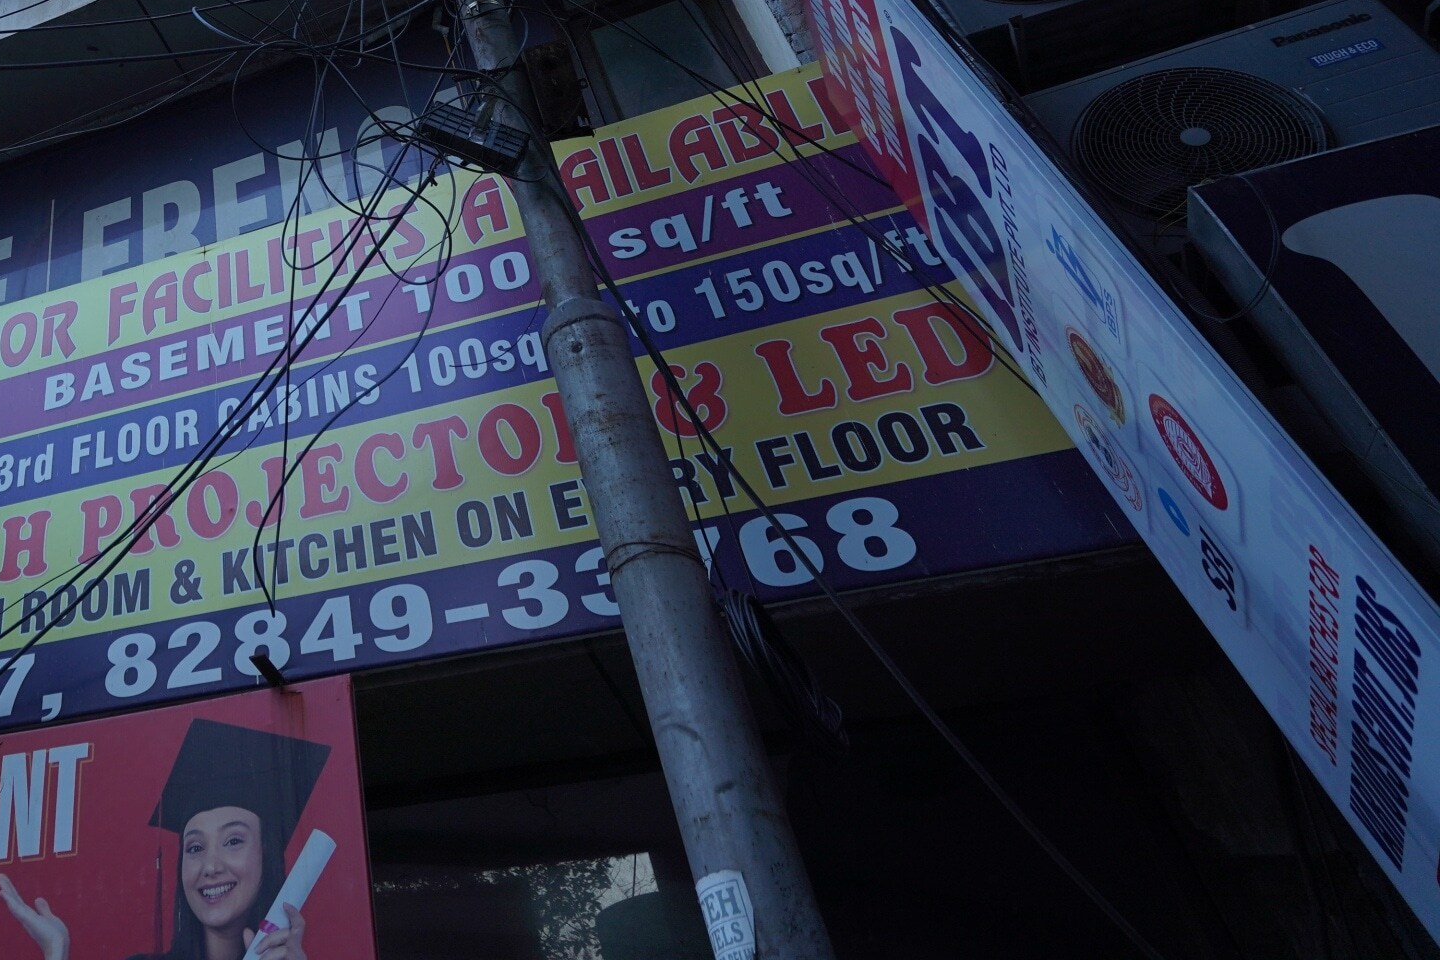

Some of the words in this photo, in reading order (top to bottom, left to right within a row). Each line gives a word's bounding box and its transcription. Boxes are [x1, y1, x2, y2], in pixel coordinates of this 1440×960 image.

[1270, 11, 1373, 48] Panasonic
[1312, 48, 1348, 67] TOUGH
[1355, 40, 1379, 55] ECO
[862, 55, 907, 174] THINK
[989, 142, 1012, 198] LTD
[81, 87, 460, 282] FRENC
[107, 204, 428, 346] FACILITIES
[459, 76, 856, 248] AAILABL
[891, 25, 1023, 353] IBT
[42, 291, 373, 412] BASEMENT
[402, 250, 532, 316] 100
[608, 180, 793, 260] sq/ft
[71, 408, 200, 476] FLOOR
[217, 362, 381, 431] CABINS
[694, 227, 948, 320] 150sq/ft
[1008, 239, 1042, 355] INSTITUTE
[1104, 288, 1118, 339] IBPS
[651, 361, 728, 438] &
[754, 301, 996, 416] LED
[1027, 342, 1048, 389] IBT
[21, 567, 152, 640] ROOM
[169, 558, 204, 606] &
[221, 510, 439, 596] KITCHEN
[455, 490, 534, 549] ON
[549, 447, 740, 532] ERY
[755, 401, 987, 491] FLOOR
[1199, 525, 1237, 612] SBI
[1308, 544, 1341, 614] FOR
[1309, 589, 1340, 700] BATCHES
[1354, 574, 1422, 711] JOBS
[1309, 685, 1338, 767] SPECIAL
[1350, 720, 1410, 873] VARIOUS
